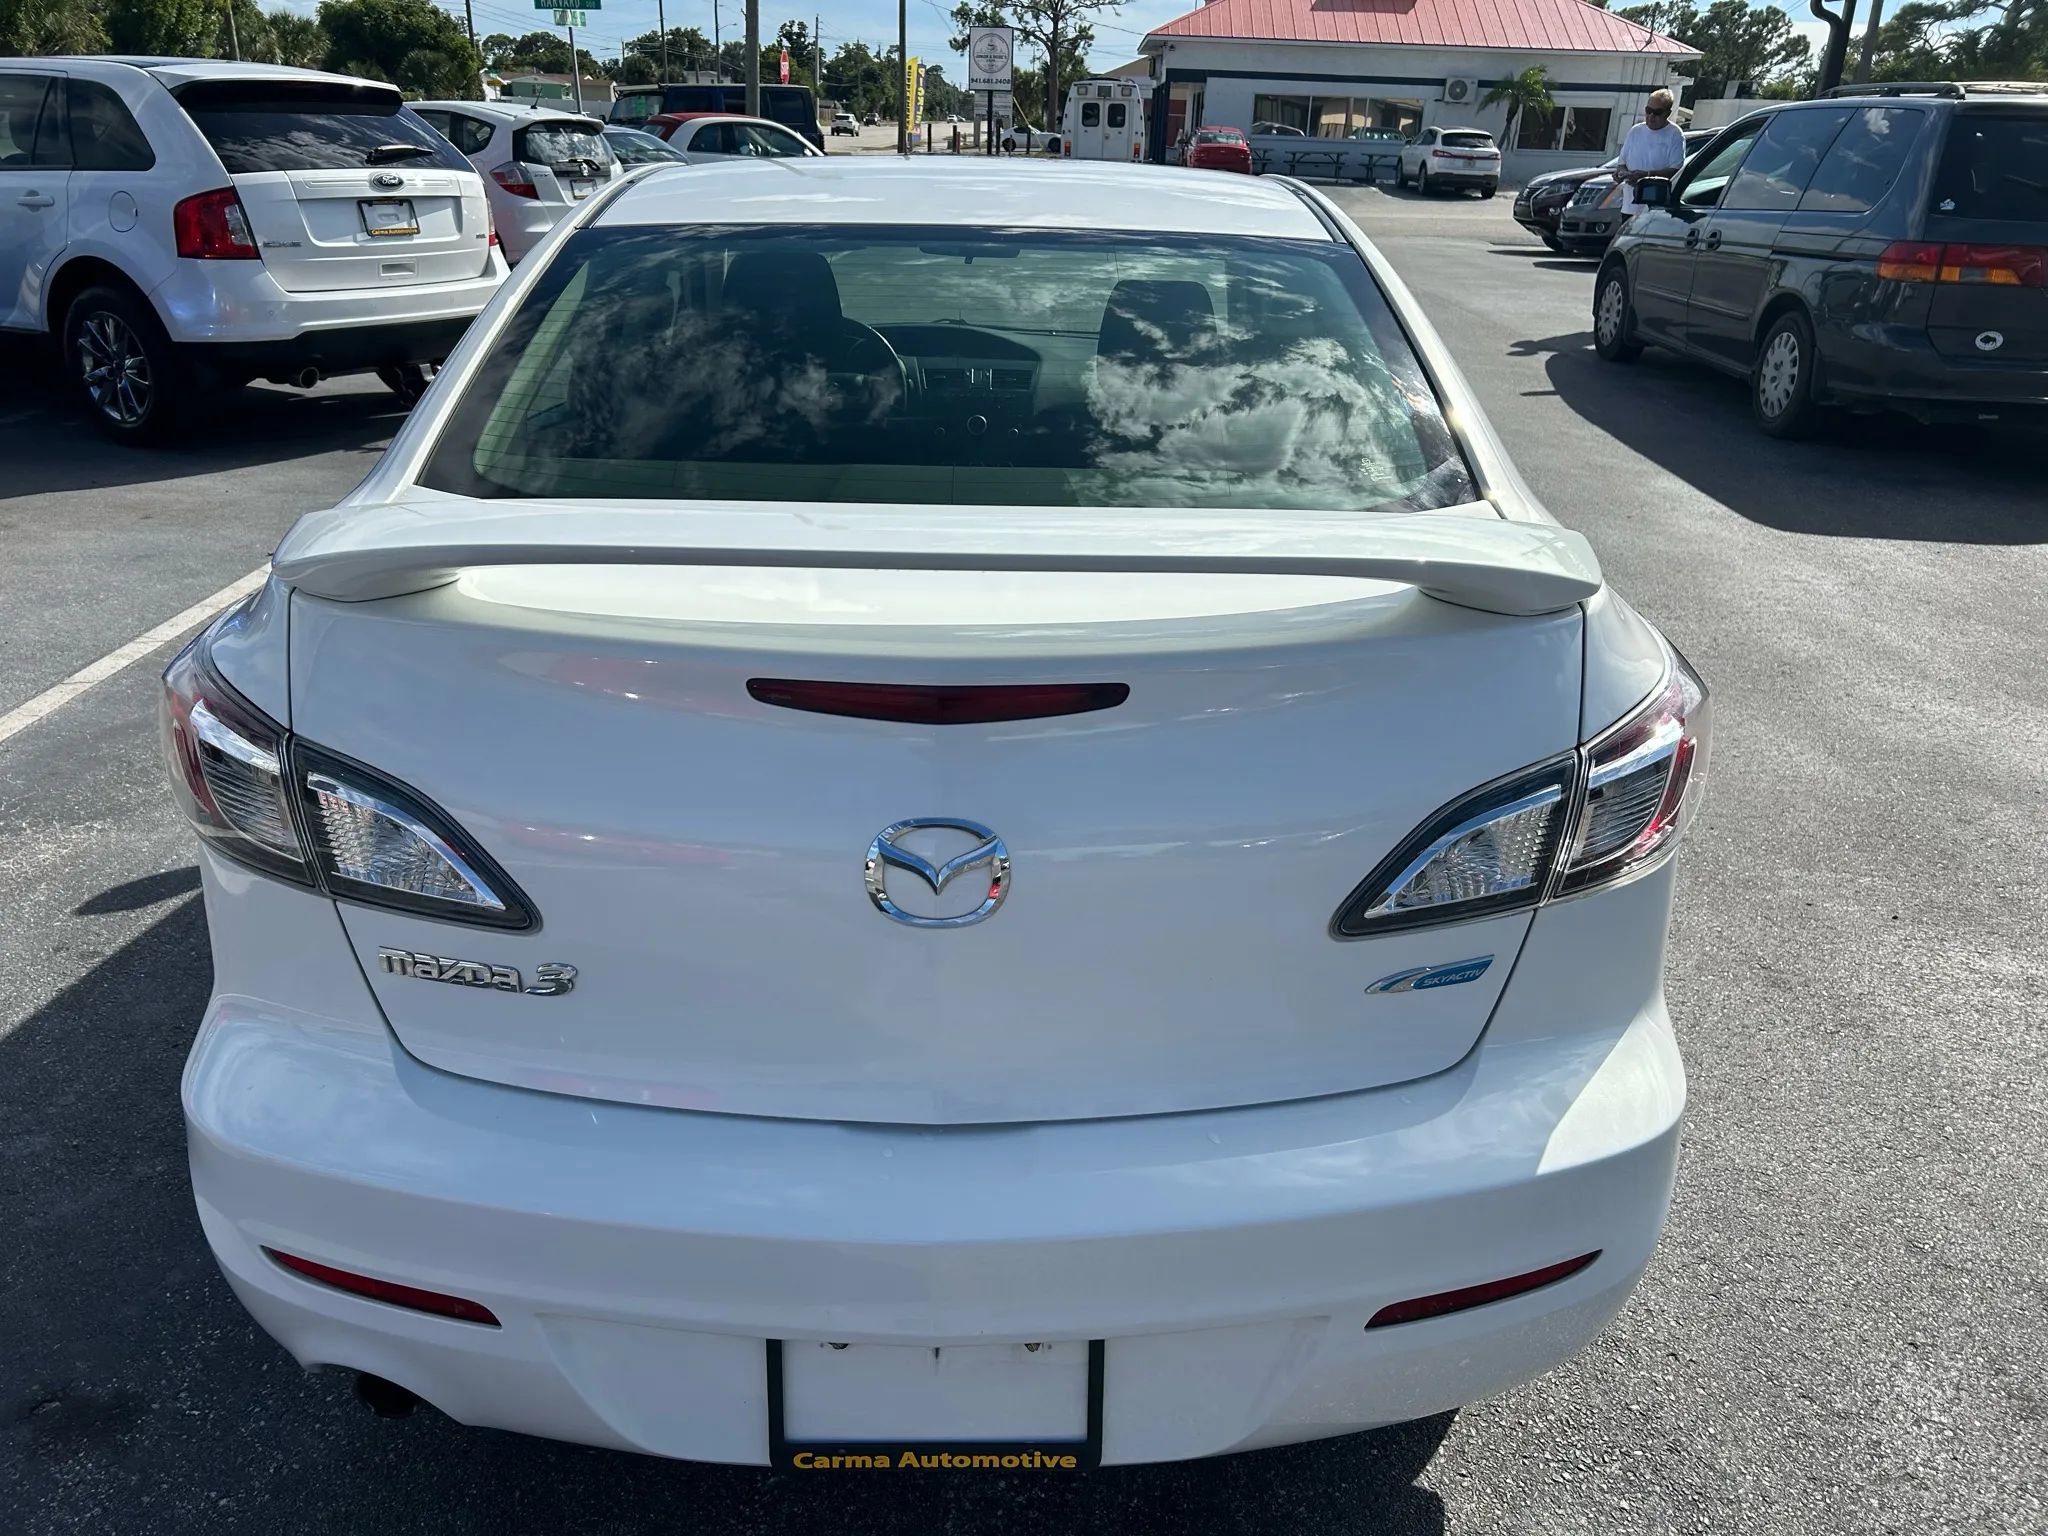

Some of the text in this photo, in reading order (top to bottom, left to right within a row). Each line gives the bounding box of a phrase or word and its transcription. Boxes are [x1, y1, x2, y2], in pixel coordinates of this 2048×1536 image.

[1423, 968, 1486, 986] SKYACTIV
[793, 1451, 1077, 1469] Carma Automotive
